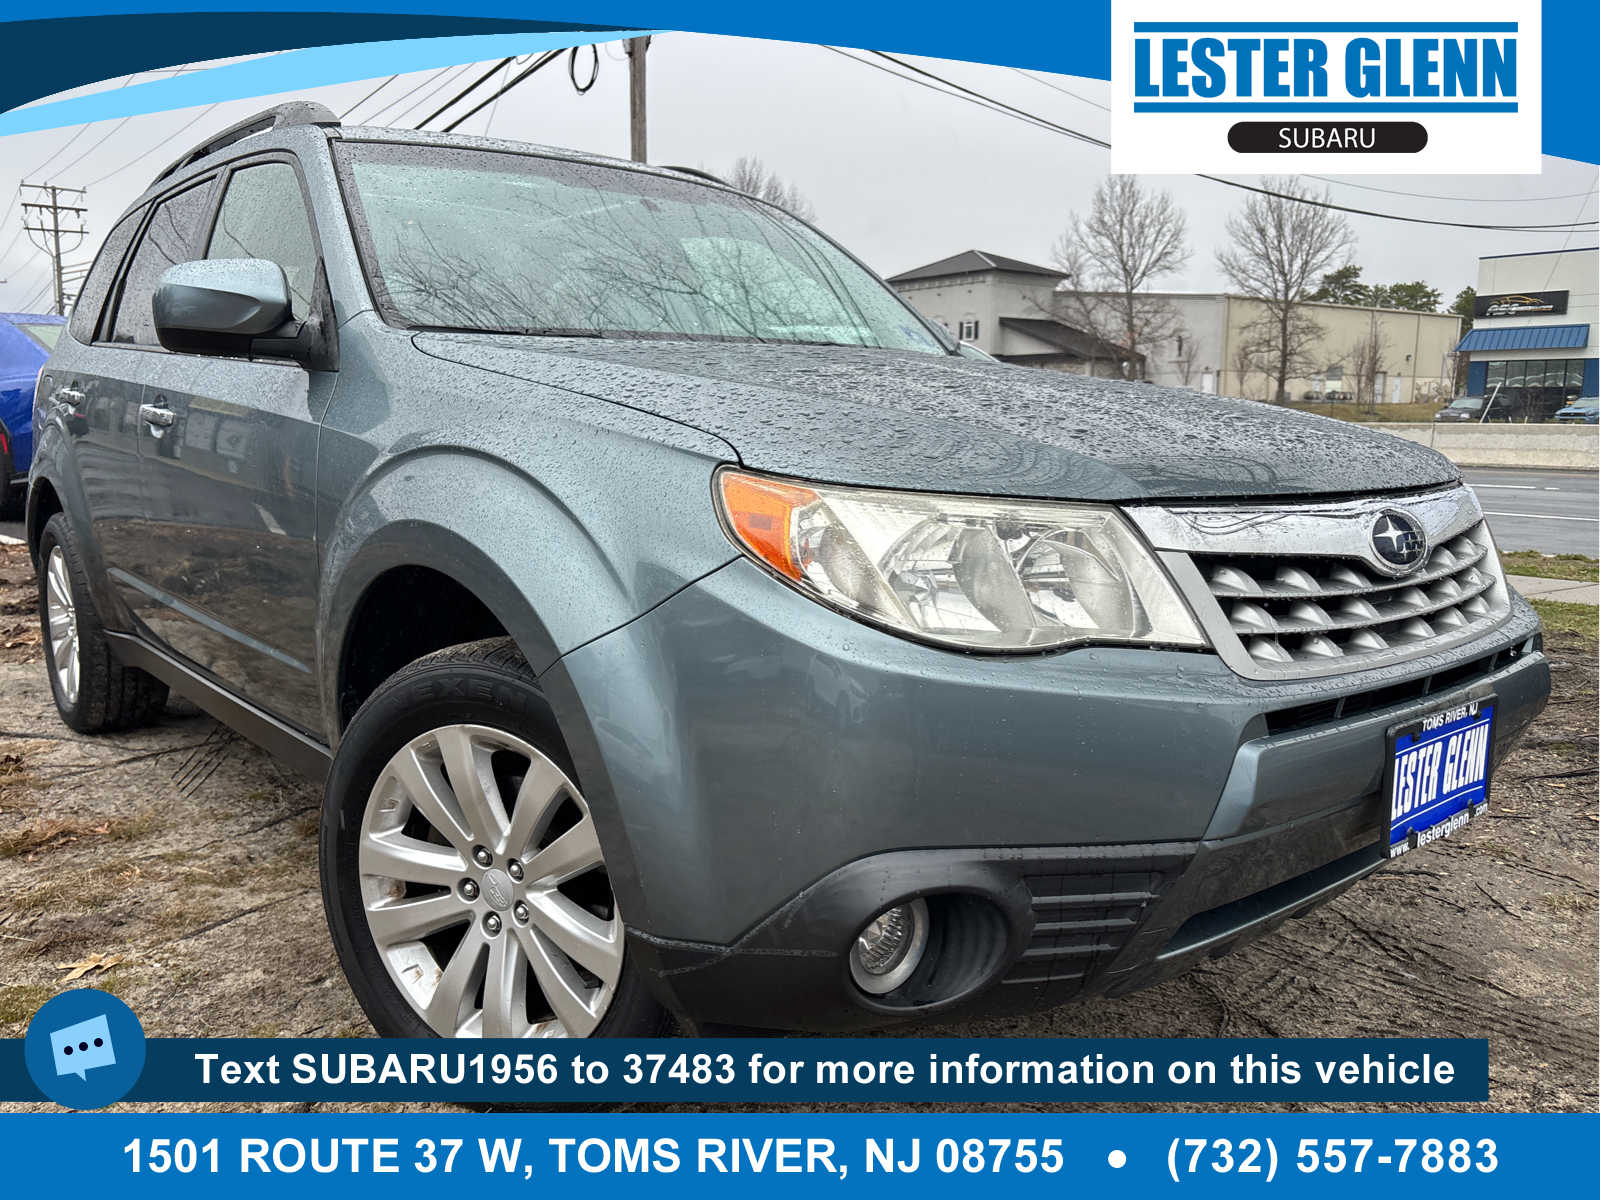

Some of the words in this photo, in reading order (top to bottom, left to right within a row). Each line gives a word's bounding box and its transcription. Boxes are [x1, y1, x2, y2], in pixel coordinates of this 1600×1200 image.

[1422, 713, 1444, 732] TOMS
[1468, 702, 1479, 716] NJ
[1391, 741, 1443, 822] LESTER
[1442, 723, 1489, 795] GLENN
